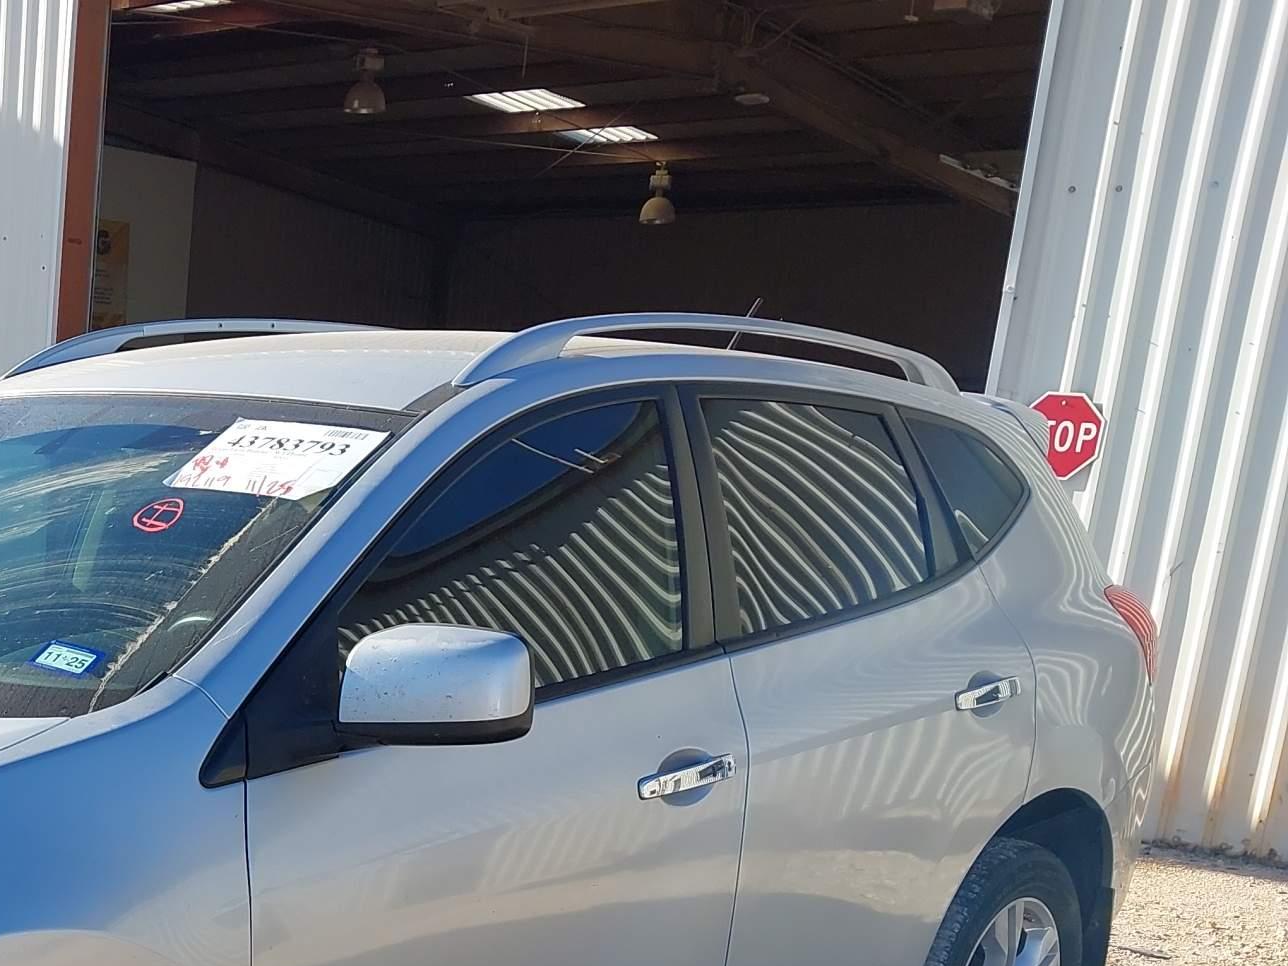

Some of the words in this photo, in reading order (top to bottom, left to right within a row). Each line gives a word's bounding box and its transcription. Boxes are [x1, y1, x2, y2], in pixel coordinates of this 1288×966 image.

[227, 435, 351, 456] 43783793
[44, 651, 61, 663] 11
[65, 656, 89, 669] 25
